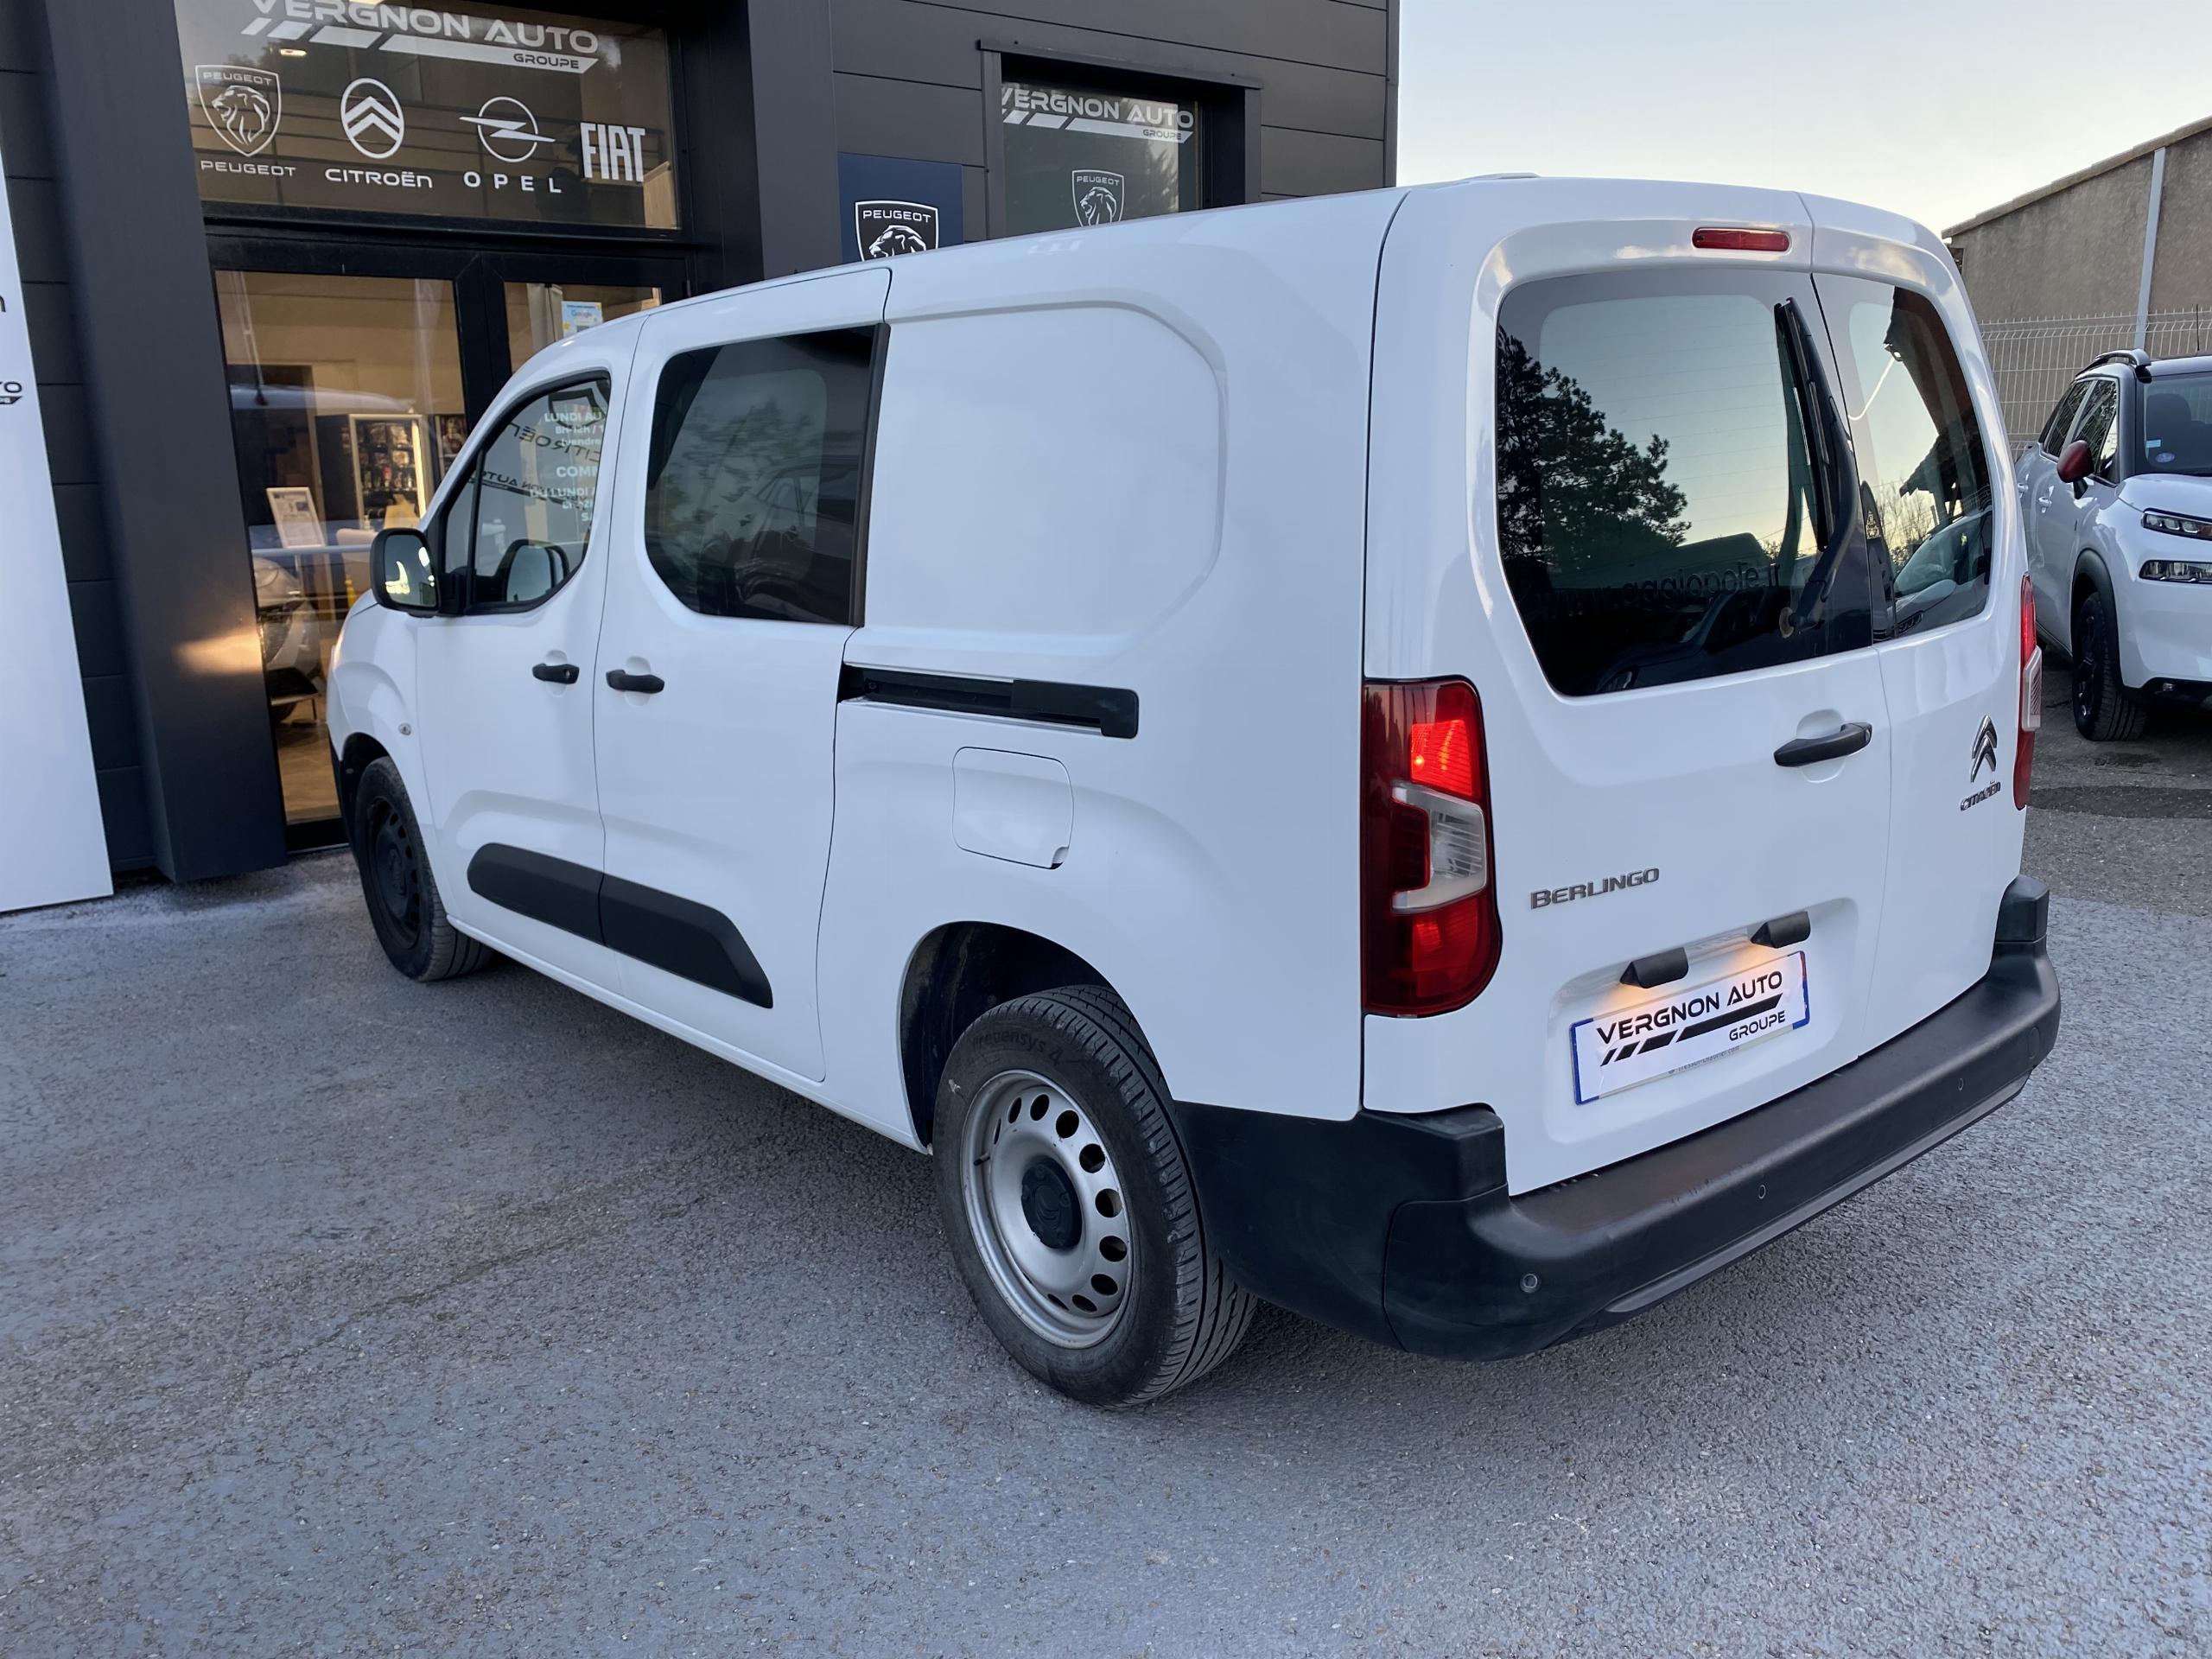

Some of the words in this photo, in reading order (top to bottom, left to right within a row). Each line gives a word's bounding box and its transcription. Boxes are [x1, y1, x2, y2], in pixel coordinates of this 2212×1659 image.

[484, 19, 599, 54] AUTO
[513, 53, 580, 70] GROUPE
[203, 71, 272, 86] PEUGEOT
[1126, 104, 1194, 129] AUTO
[1142, 129, 1182, 141] GROUPE
[580, 122, 645, 182] FIAT
[200, 160, 296, 177] PEUGEOT
[463, 170, 563, 194] OPEL
[1077, 175, 1121, 188] PEUGEOT
[862, 209, 932, 224] PEUGEOT
[544, 412, 582, 423] LUNDI
[1529, 868, 1660, 910] BERLINGO
[1596, 991, 1719, 1045] VERGNON
[1726, 970, 1783, 1007] AUTO
[1729, 1010, 1786, 1041] GROUPE
